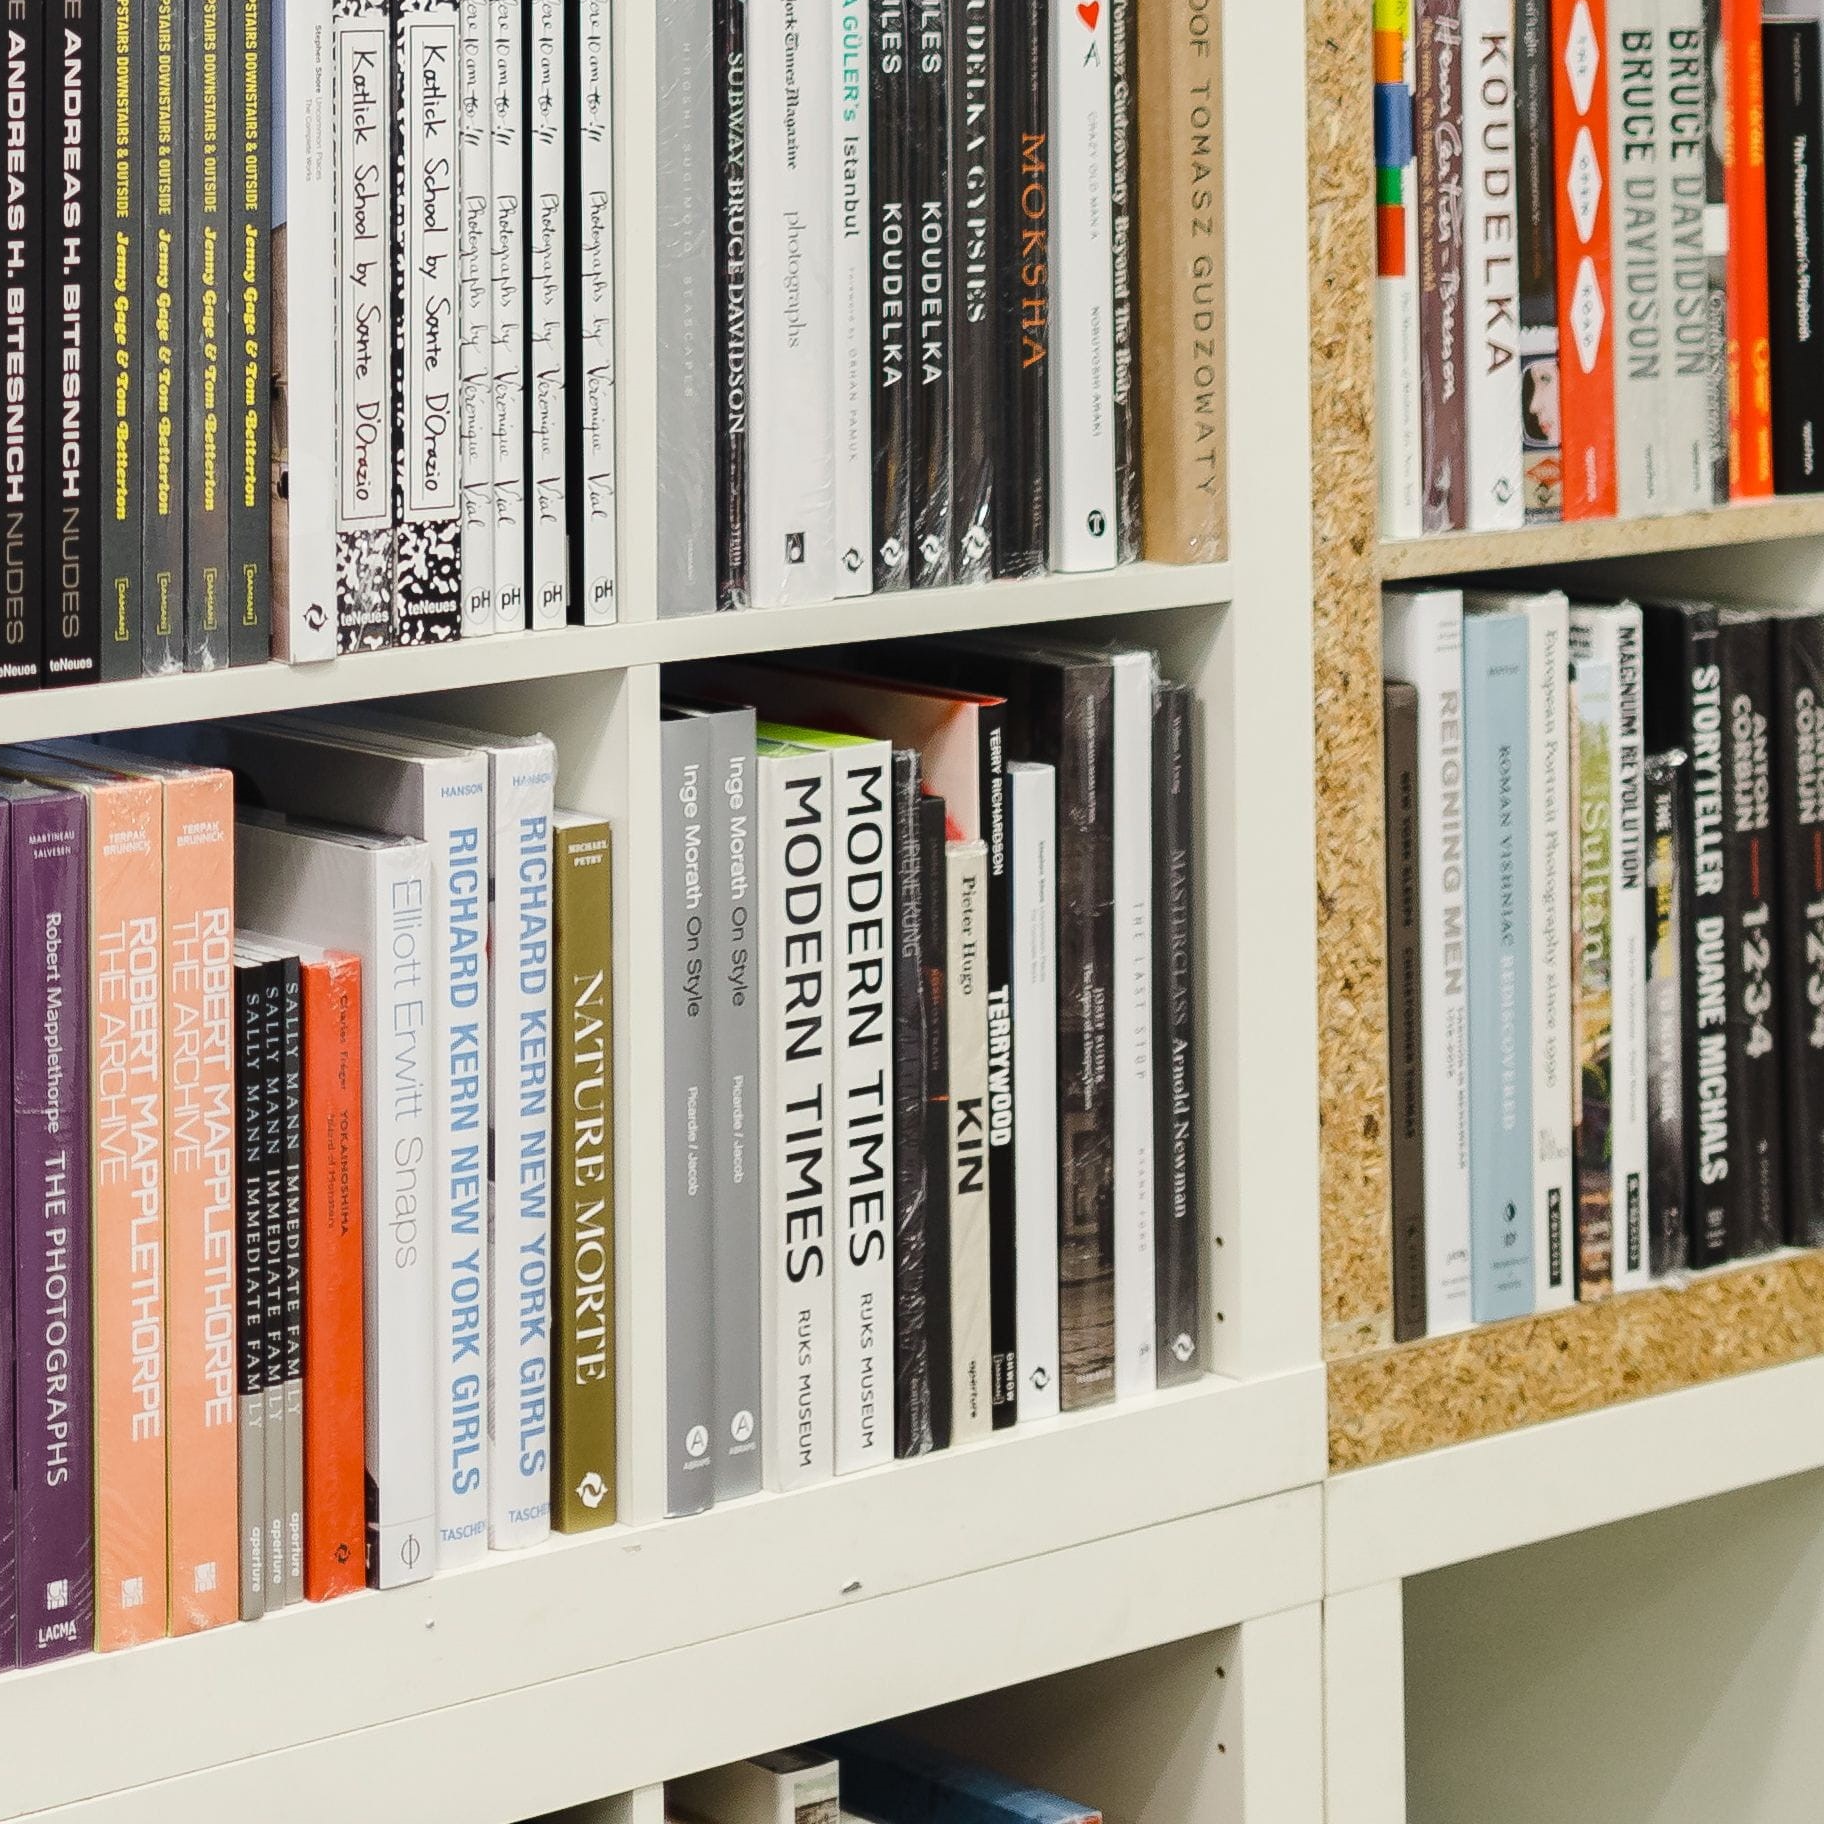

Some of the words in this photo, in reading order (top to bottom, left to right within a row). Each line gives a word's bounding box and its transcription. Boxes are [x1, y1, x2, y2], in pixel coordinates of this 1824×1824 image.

[243, 51, 257, 137] DOWNSTAIRS
[424, 44, 447, 138] Katlick
[727, 53, 744, 169] SUBWAY
[841, 15, 864, 122] GÜLER's
[1621, 32, 1654, 162] BRUCE
[62, 29, 83, 227] ANDREAS
[243, 141, 257, 151] &
[243, 154, 257, 210] OUTSIDE
[1190, 83, 1213, 239] TOMASZ
[424, 157, 448, 239] School
[727, 178, 744, 274] BRUCE
[842, 137, 862, 238] Istanbul
[1480, 33, 1514, 375] KOUDELKA
[62, 237, 82, 276] H.
[421, 254, 445, 280] by
[920, 202, 943, 386] KOUDELKA
[1019, 133, 1047, 370] MOKSHA
[1625, 177, 1658, 381] DAVIDSON
[61, 283, 82, 497] BITESNICH
[425, 293, 447, 371] Sante
[727, 282, 745, 434] DAVIDSON
[1193, 257, 1216, 496] GUDZOWATY
[61, 507, 81, 638] NUDES
[680, 764, 701, 825] Inge
[1692, 665, 1724, 895] STORYTELLER
[448, 828, 478, 1008] RICHARD
[682, 823, 703, 910] Morath
[784, 778, 825, 1062] MODERN
[847, 767, 885, 1048] MODERN
[959, 875, 978, 936] Pieter
[201, 908, 230, 1079] ROBERT
[390, 880, 423, 989] Elliott
[681, 958, 704, 1018] Style
[684, 915, 703, 954] On
[959, 943, 977, 995] Hugo
[1697, 917, 1724, 1027] DUANE
[284, 982, 299, 1062] SALLY
[391, 1001, 423, 1121] Erwitt
[448, 1023, 478, 1133] KERN
[574, 969, 605, 1183] NATURE
[988, 984, 1011, 1145] TERRYWOOD
[285, 1073, 300, 1150] MANN
[957, 1098, 982, 1194] KIN
[1699, 1035, 1727, 1183] MICHALS
[384, 1139, 423, 1268] Snaps
[449, 1146, 479, 1235] NEW
[785, 1082, 825, 1284] TIMES
[848, 1071, 885, 1267] TIMES
[201, 1085, 233, 1425] MAPPLETHORPE
[286, 1163, 300, 1326] IMMEDIATE
[575, 1200, 606, 1385] MORTE
[450, 1250, 480, 1361] YORK
[286, 1335, 301, 1416] FAMILY
[450, 1374, 481, 1495] GIRLS
